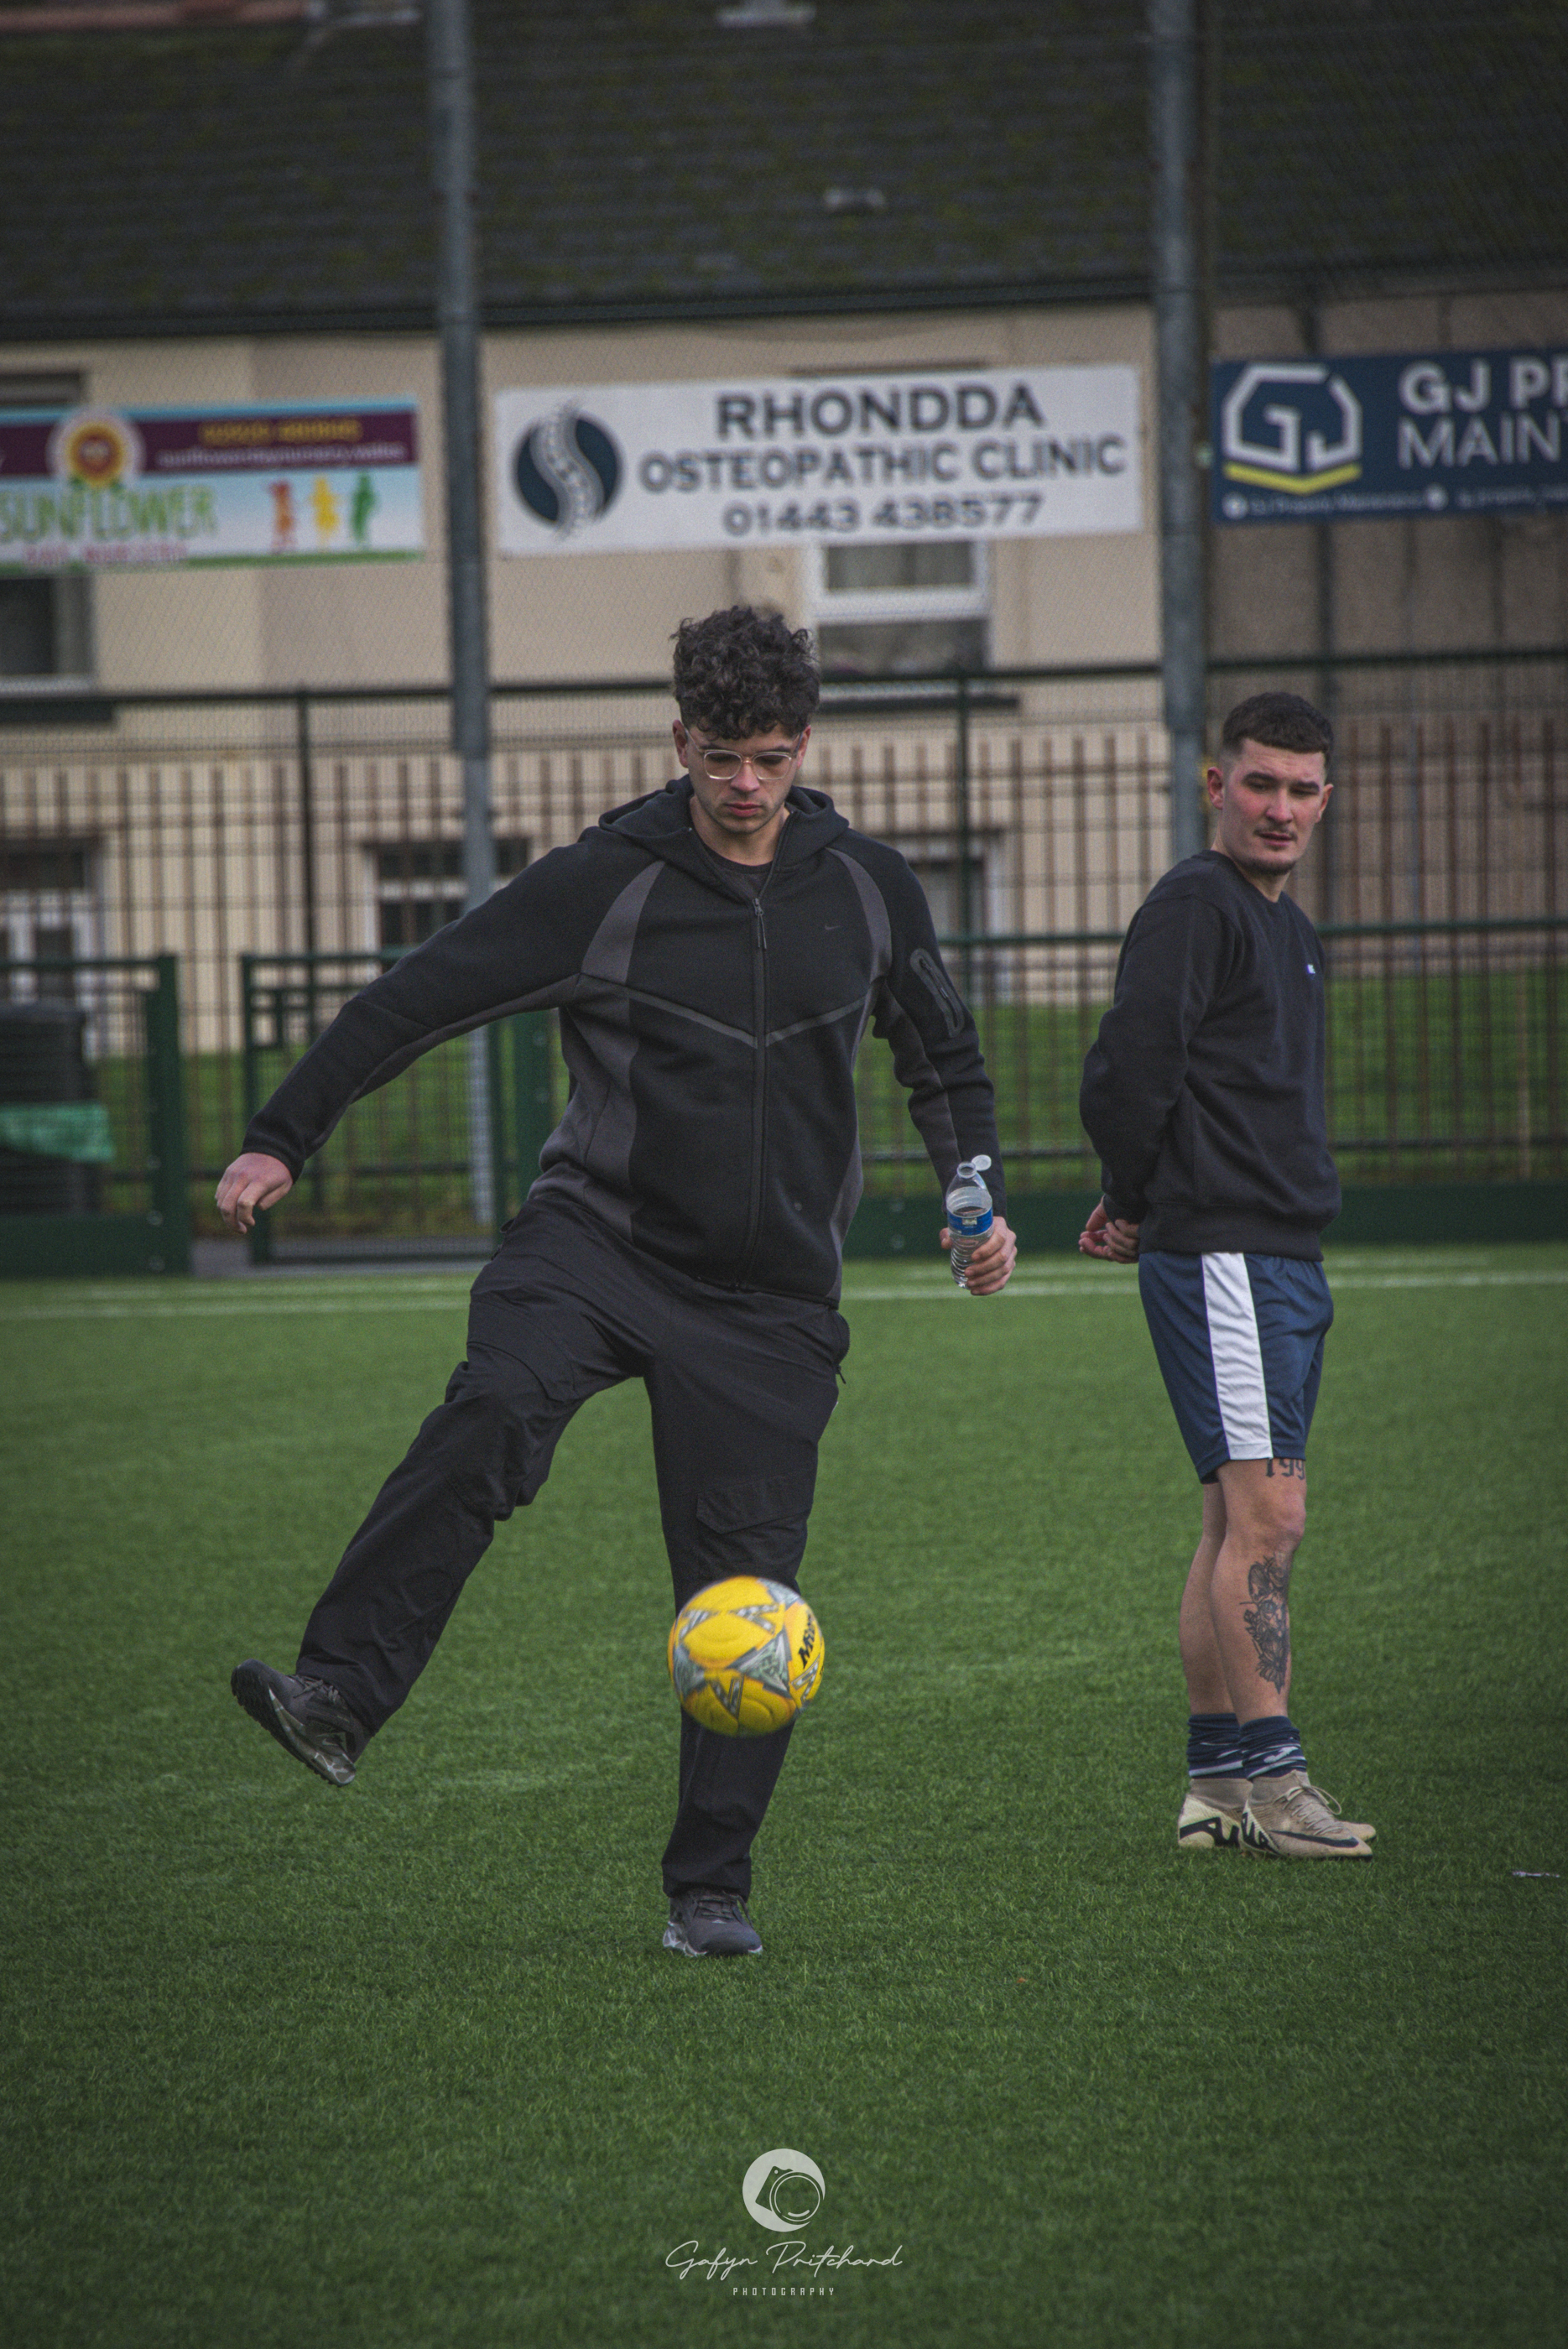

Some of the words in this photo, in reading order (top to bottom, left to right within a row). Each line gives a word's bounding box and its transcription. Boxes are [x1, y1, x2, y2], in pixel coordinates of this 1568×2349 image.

[716, 383, 1045, 439] RHONDDA
[1399, 357, 1491, 414] GJ
[639, 442, 959, 492] OSTEOPATHIC
[972, 435, 1128, 482] CLINIC
[1398, 410, 1568, 468] MAIN
[722, 500, 862, 535] 01443
[872, 491, 1043, 529] 438577
